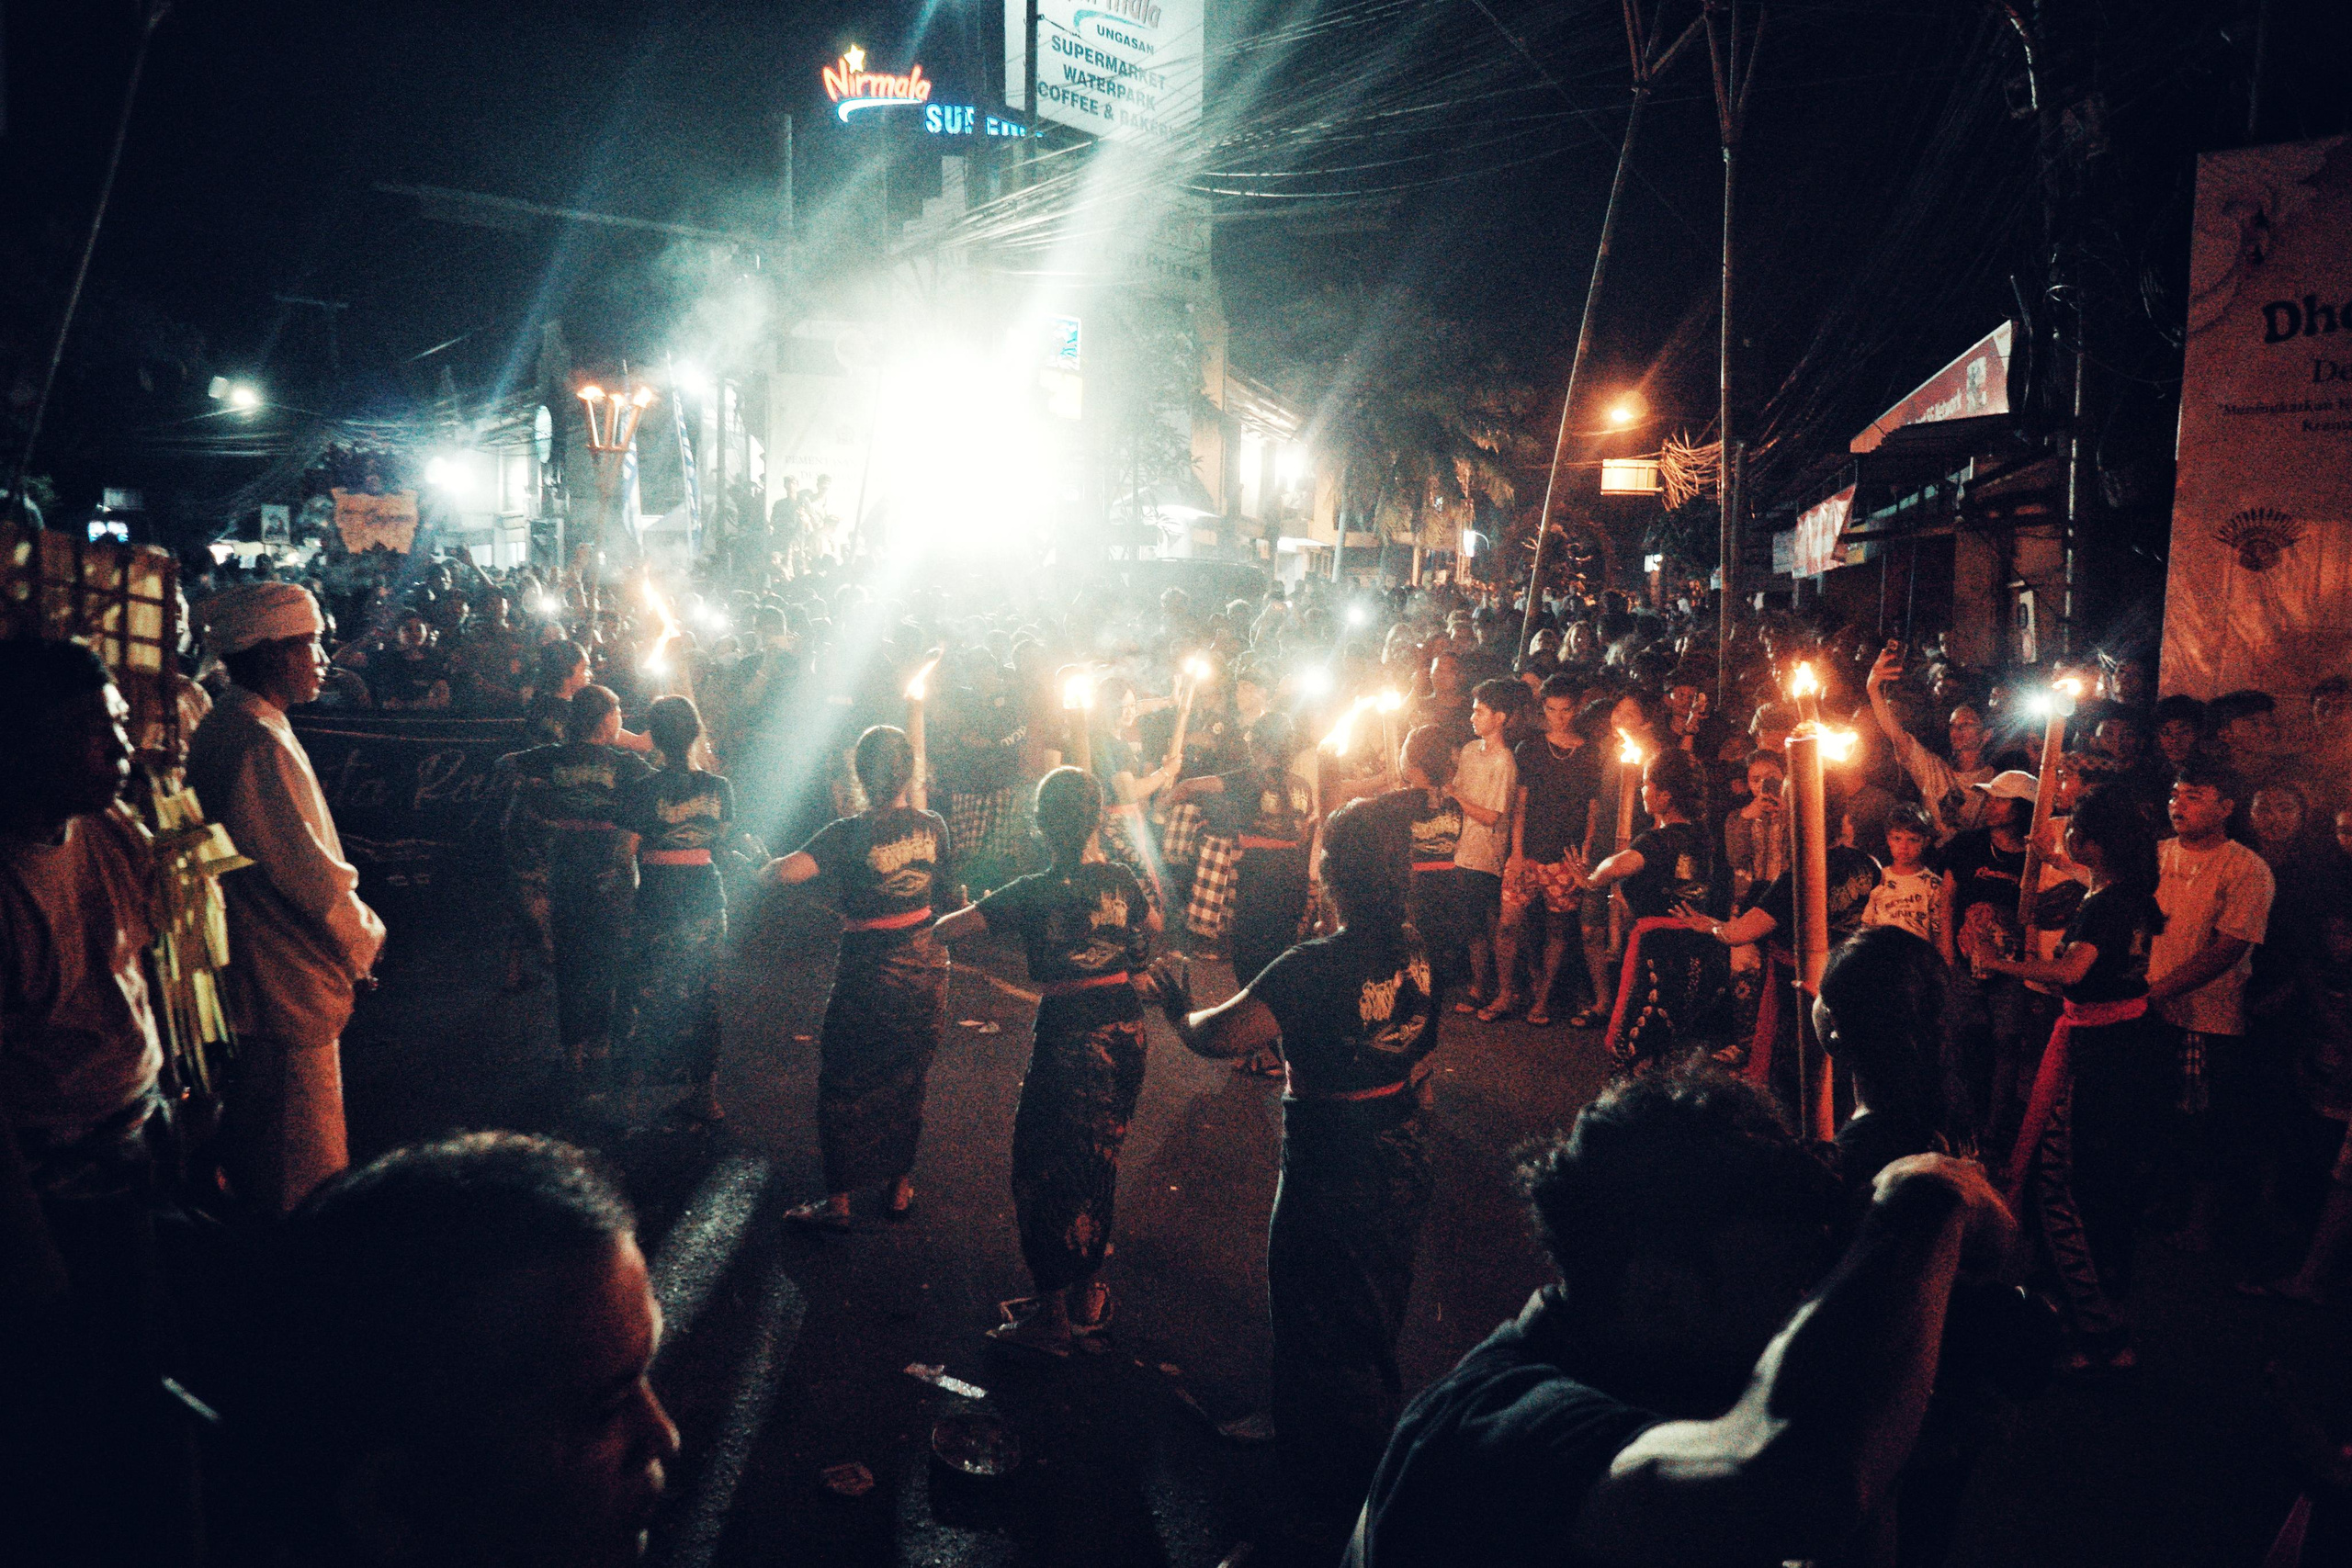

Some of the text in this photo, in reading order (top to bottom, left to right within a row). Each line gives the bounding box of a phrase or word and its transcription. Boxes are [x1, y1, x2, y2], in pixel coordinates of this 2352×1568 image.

[1096, 24, 1155, 54] UNGASAN
[822, 57, 931, 102] Nirmala
[1051, 35, 1166, 90] SUPERMARKET
[1037, 80, 1100, 116] COFFEE
[1103, 103, 1114, 120] &
[1063, 63, 1156, 111] WATERPARK
